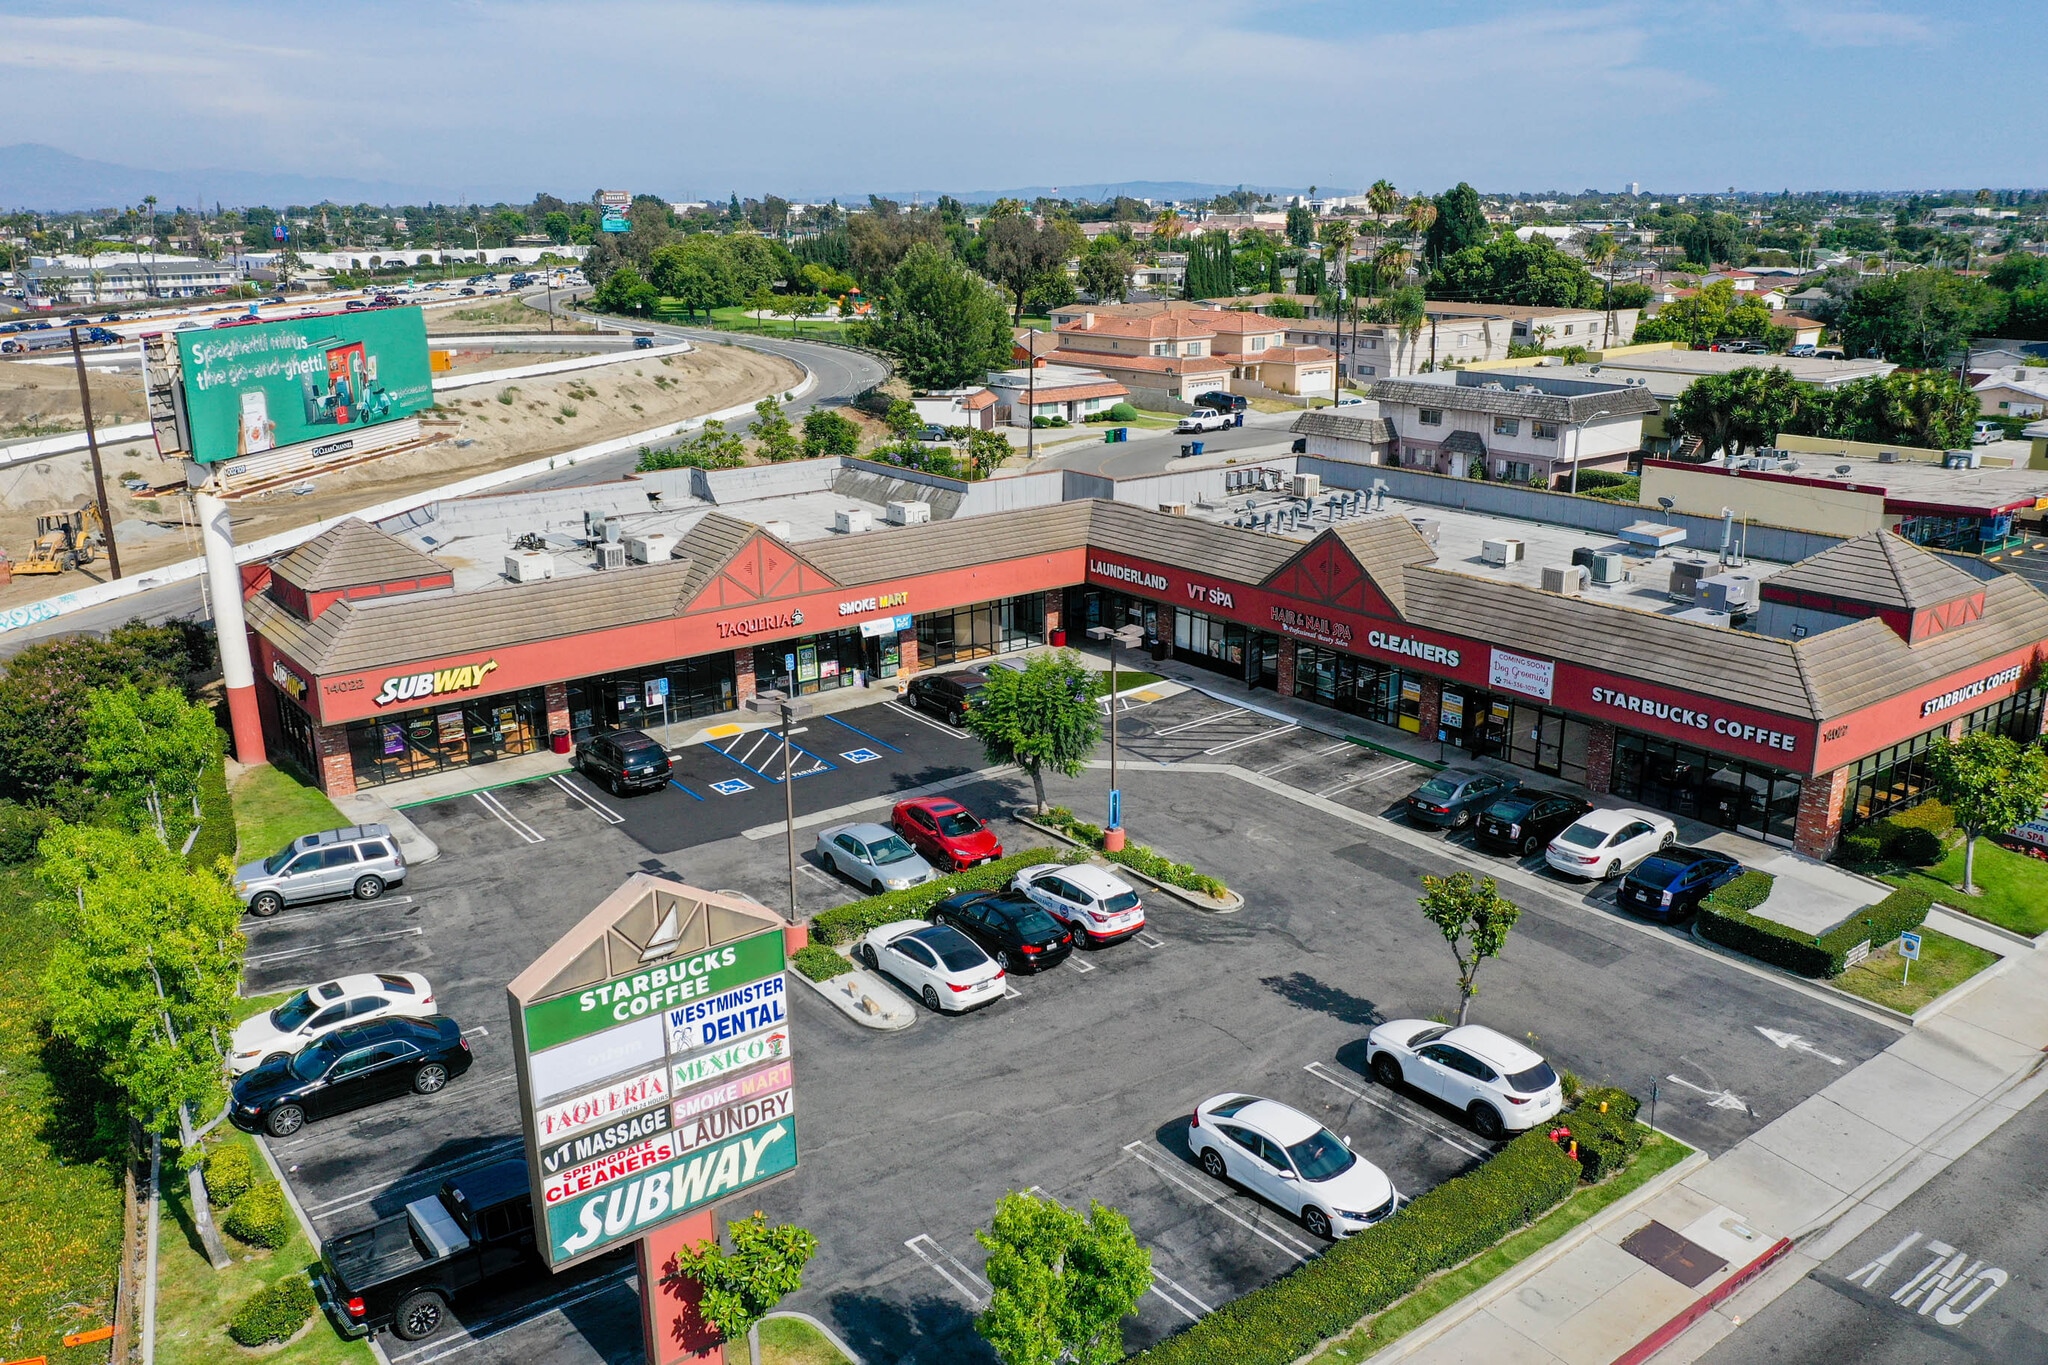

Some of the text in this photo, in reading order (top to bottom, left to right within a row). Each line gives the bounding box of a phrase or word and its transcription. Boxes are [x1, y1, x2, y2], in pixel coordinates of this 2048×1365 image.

[191, 331, 308, 368] Spaghetti minus
[196, 369, 227, 391] the
[1090, 559, 1168, 591] LAUNDERLAND
[838, 592, 908, 615] SMOKE MART
[1187, 583, 1233, 609] VT SPA
[718, 614, 791, 638] TAQUERIA
[1270, 606, 1352, 640] HAIR & NAIL SPA
[1368, 630, 1461, 668] CLEANERS
[1498, 653, 1545, 670] COMING SOON
[273, 660, 307, 700] SUBWAY
[324, 679, 364, 695] 14022
[374, 658, 499, 705] SUBWAY
[1494, 660, 1549, 687] Dog Grooming
[1923, 665, 2022, 716] STARBUCKS COFFEE
[1591, 686, 1796, 751] STARBUCKS COFFEE
[791, 765, 828, 777] PARKING
[2026, 831, 2045, 843] SPA
[579, 947, 737, 1012] STARBUCKS
[612, 975, 710, 1021] COFFEE
[670, 977, 784, 1027] WESTMINSTER
[702, 999, 785, 1045] DENTAL
[676, 1039, 764, 1086] MEXICO
[621, 1094, 669, 1116] OPEN 24 HOURS
[675, 1066, 791, 1119] SMOKE MART
[544, 1108, 667, 1173] VT MASSAGE
[679, 1091, 790, 1152] LAUNDRY
[545, 1144, 671, 1202] CLEANERS
[562, 1139, 653, 1182] SPRINGDALE
[562, 1122, 787, 1255] SUBWAY
[1846, 1231, 2009, 1327] ONLY
